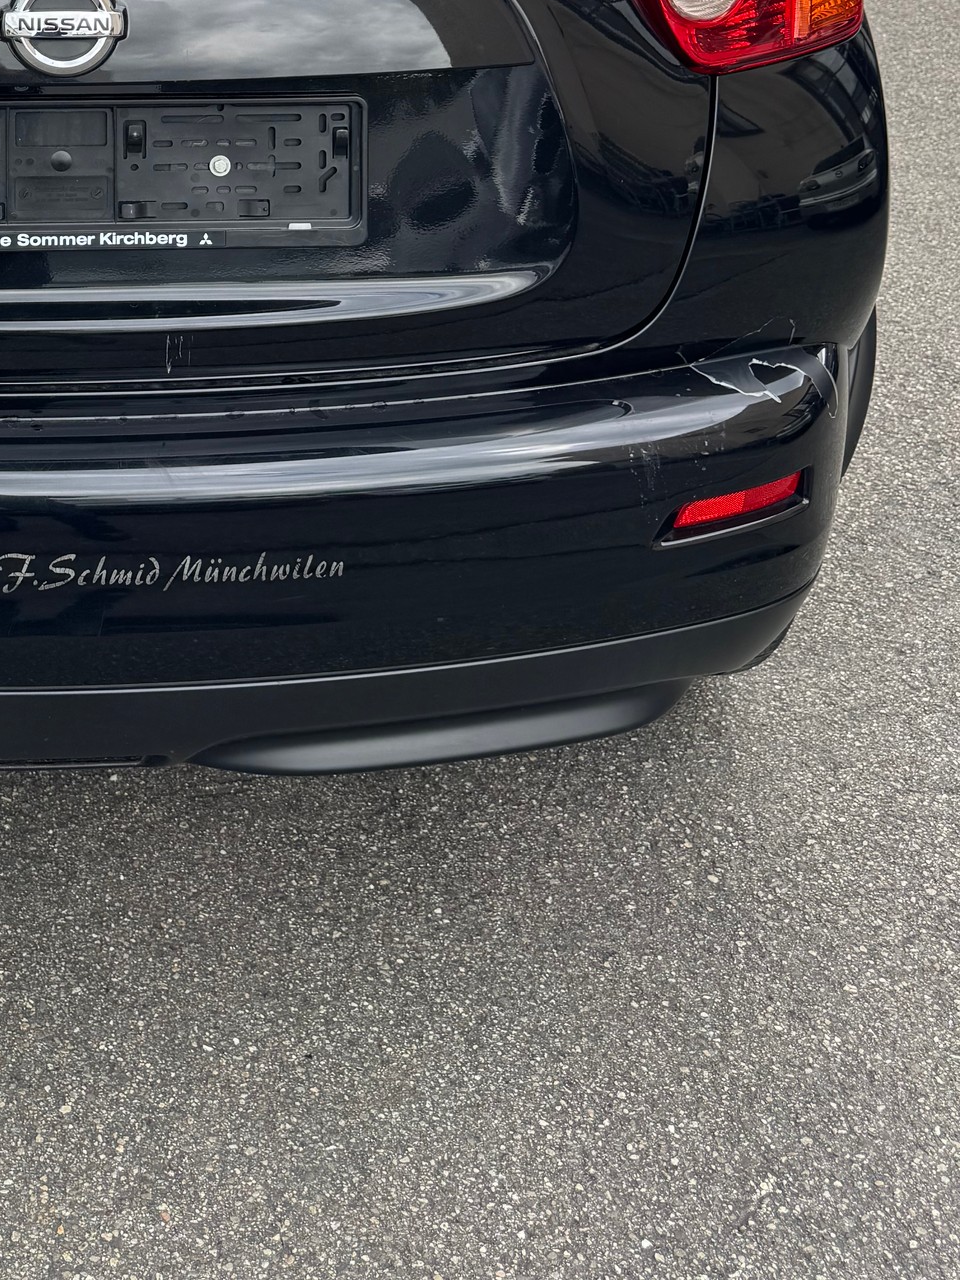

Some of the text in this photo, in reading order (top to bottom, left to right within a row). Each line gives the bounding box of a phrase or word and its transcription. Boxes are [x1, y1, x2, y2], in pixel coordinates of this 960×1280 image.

[16, 16, 111, 33] NISSAN
[16, 232, 96, 247] Sommer
[99, 230, 188, 249] Kirchberg
[163, 550, 345, 592] Münchwilen
